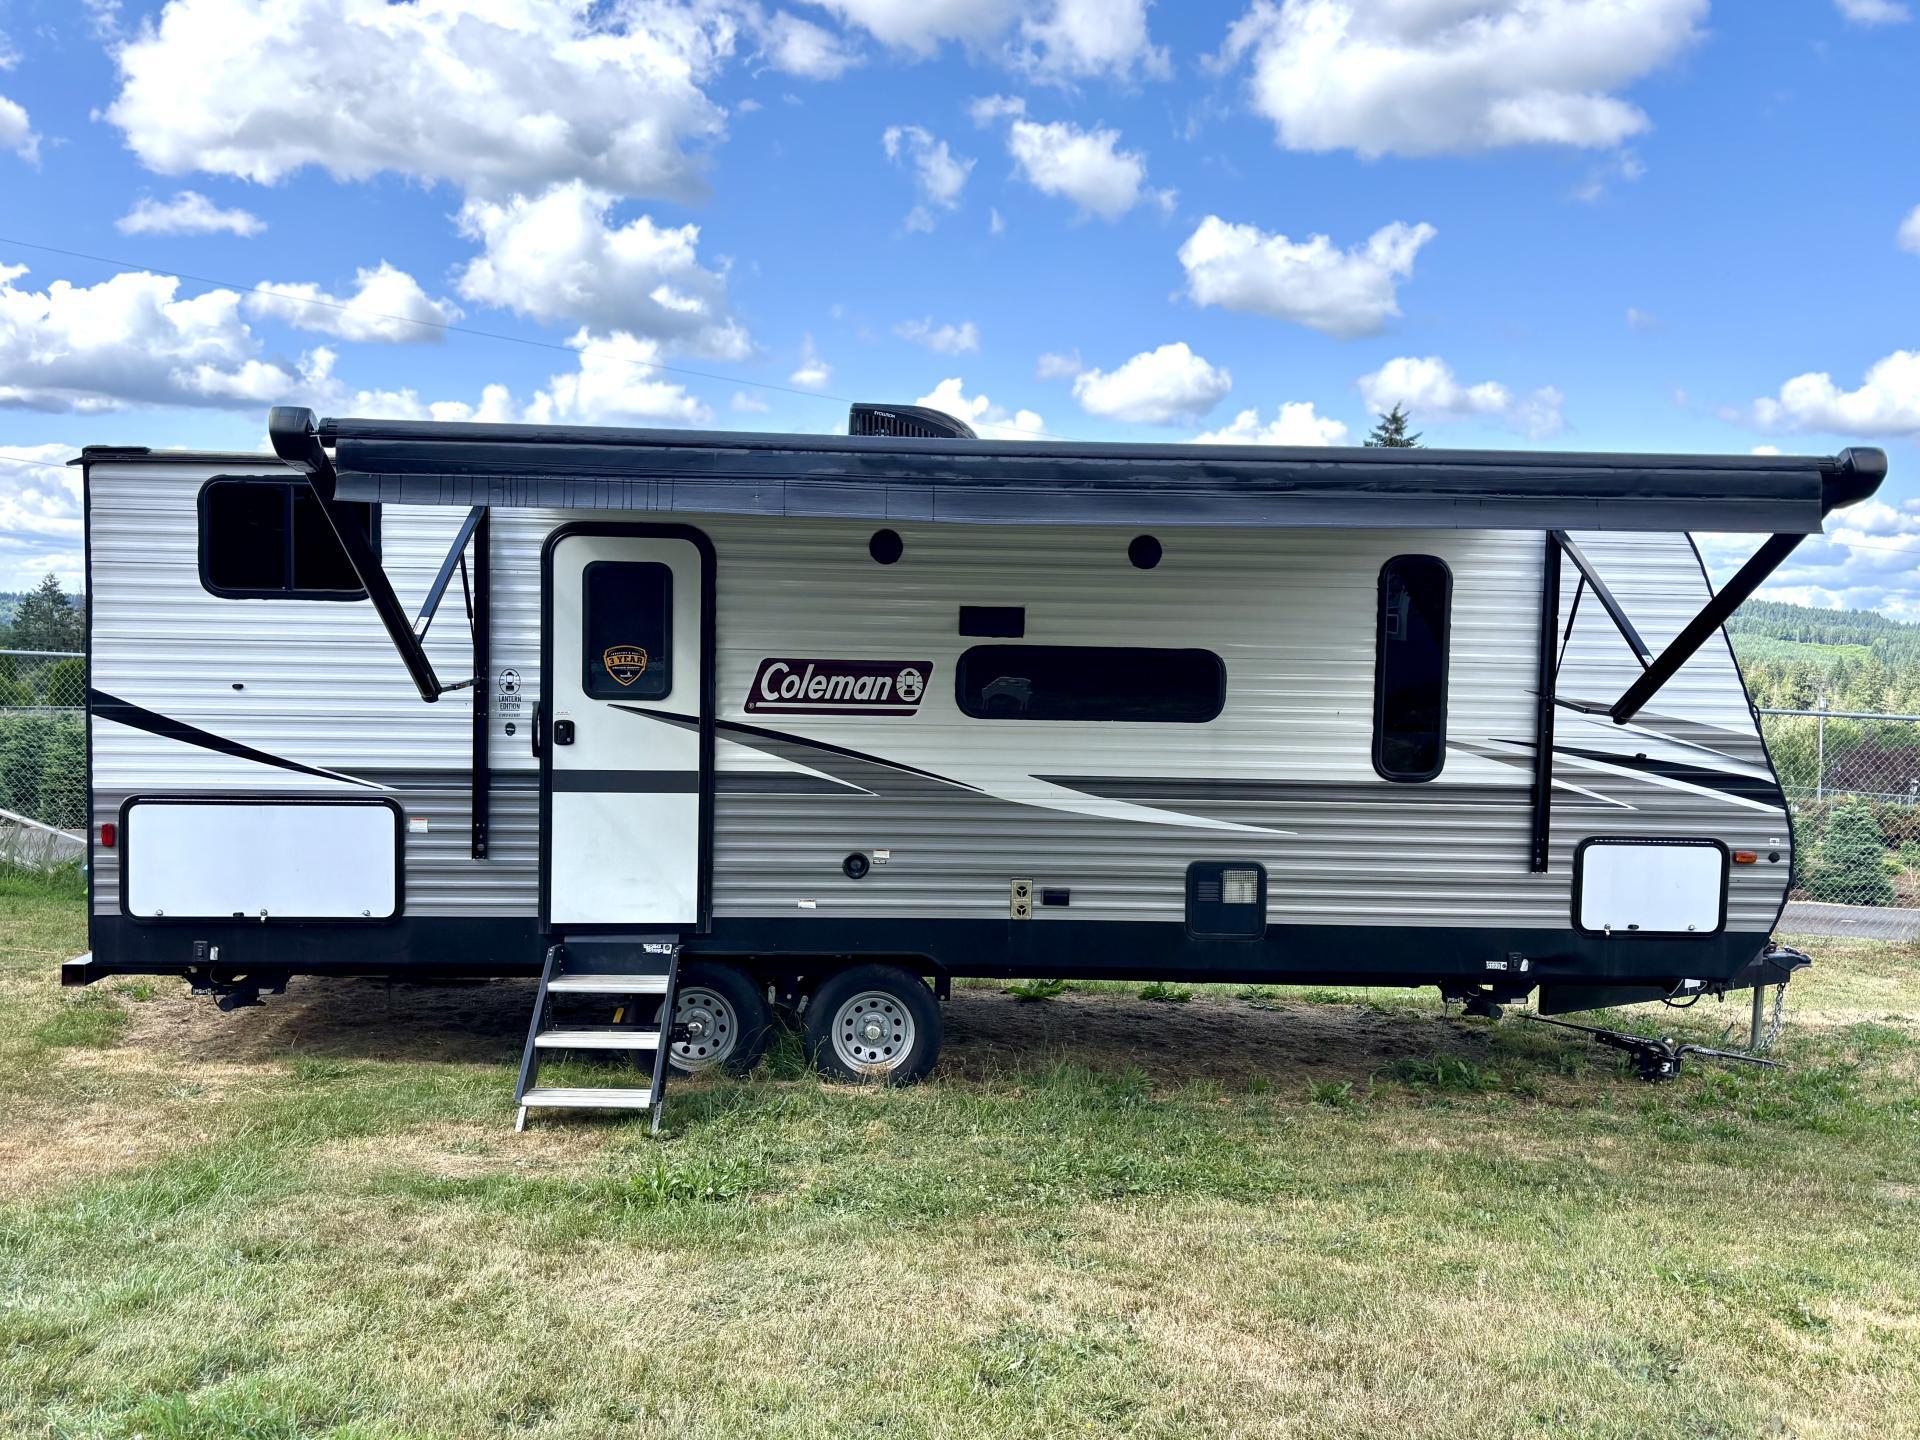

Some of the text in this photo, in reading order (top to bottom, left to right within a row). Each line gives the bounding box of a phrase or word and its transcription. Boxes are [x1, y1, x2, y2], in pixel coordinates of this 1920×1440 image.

[873, 410, 896, 419] EVOLUTION
[608, 656, 643, 665] 3 YEAR
[761, 662, 892, 701] Coleman
[1660, 1062, 1671, 1073] 3
